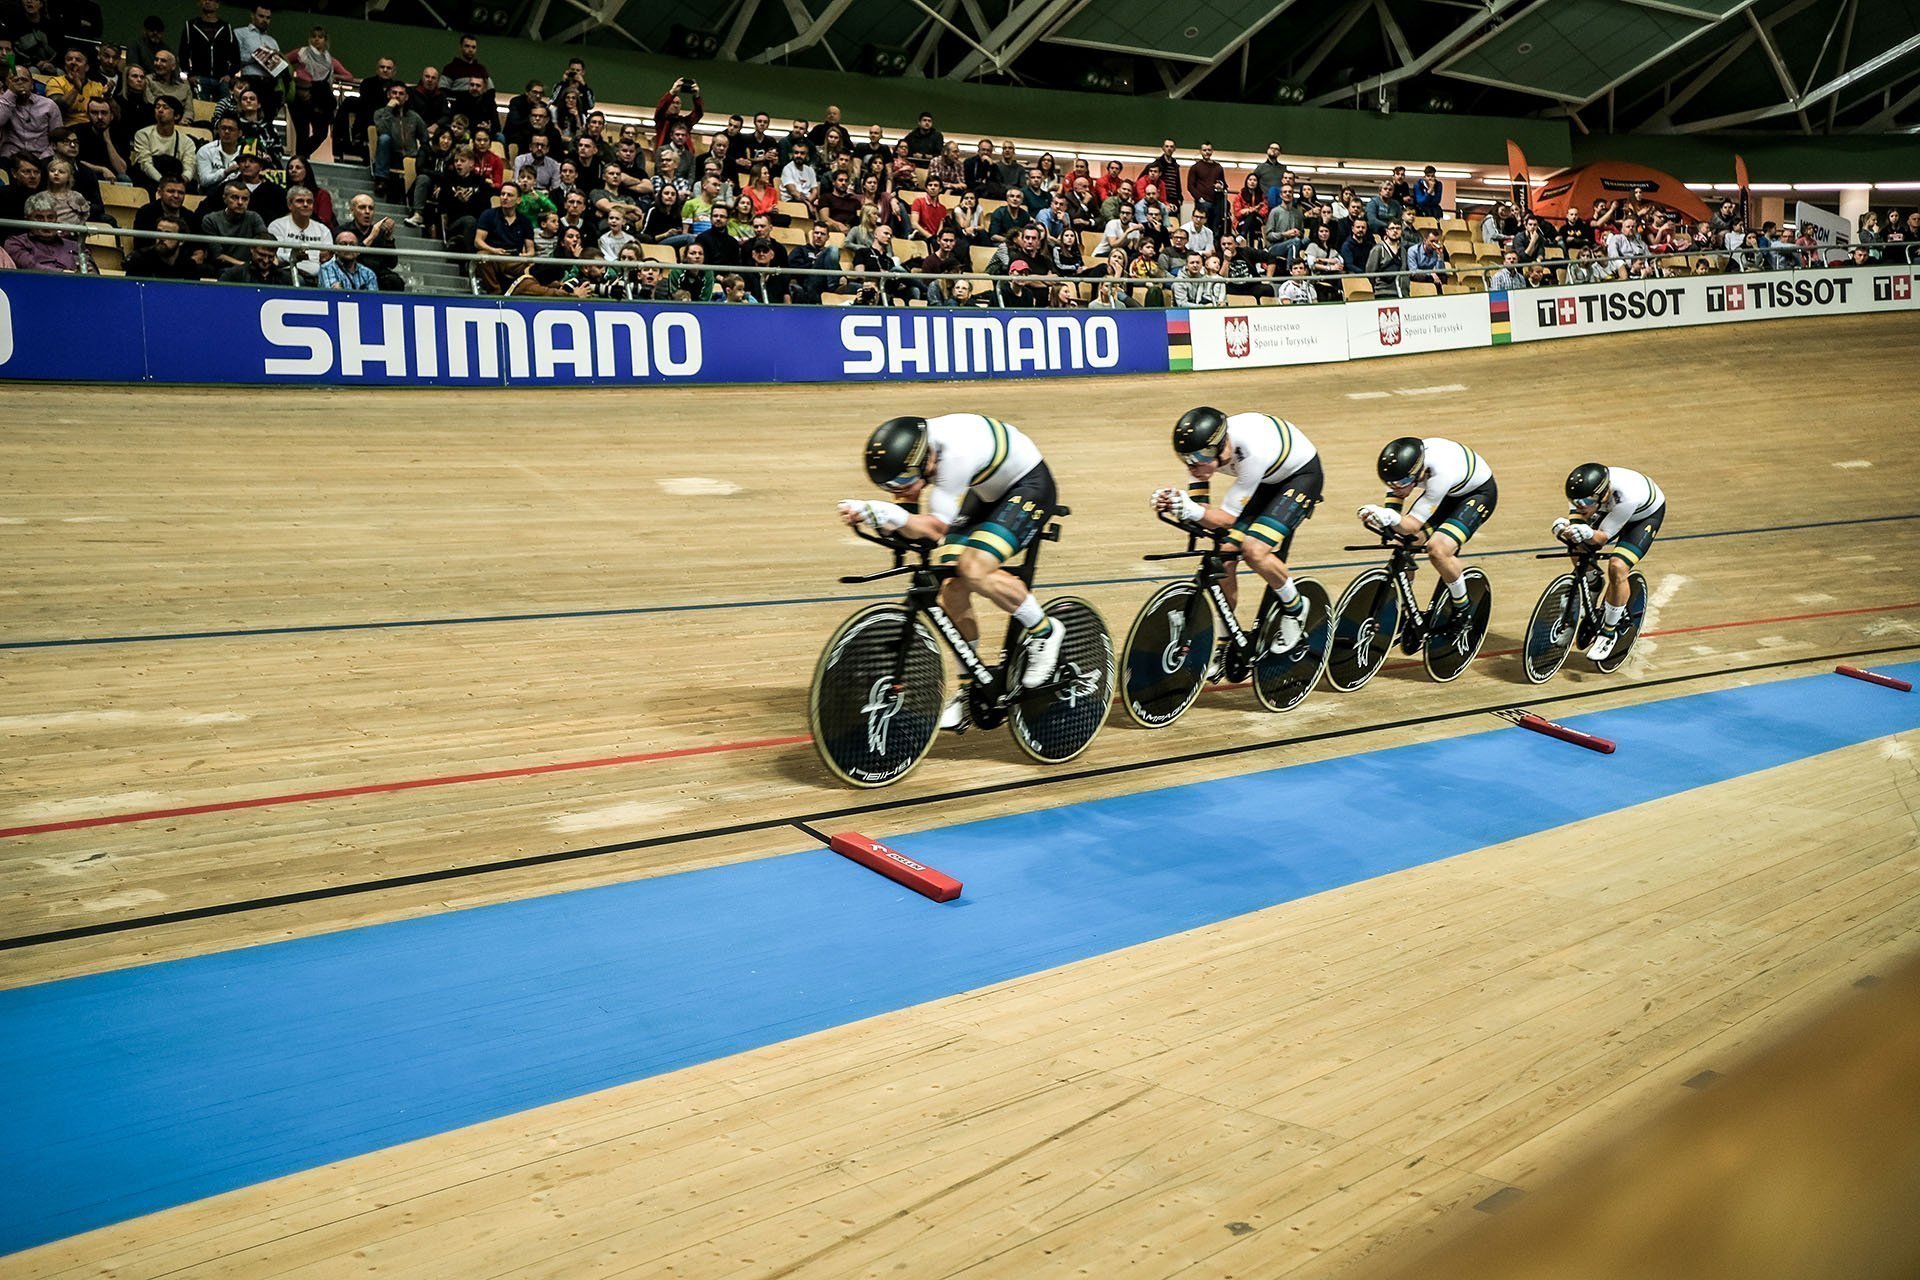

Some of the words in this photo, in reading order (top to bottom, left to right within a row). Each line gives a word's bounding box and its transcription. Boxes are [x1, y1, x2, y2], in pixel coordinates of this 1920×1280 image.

[1747, 278, 1852, 309] TISSOT
[1404, 312, 1447, 321] Ministerstwo
[1579, 288, 1685, 323] TISSOT
[261, 298, 702, 377] SHIMANO
[1253, 323, 1300, 332] Ministerstwo
[1404, 328, 1427, 337] Sportu
[1433, 323, 1463, 335] Turystyki
[840, 315, 1119, 373] SHIMANO
[1254, 339, 1278, 349] Sportu
[1286, 336, 1318, 347] Turystyki
[1008, 495, 1045, 520] AUS
[1283, 488, 1311, 509] AUS
